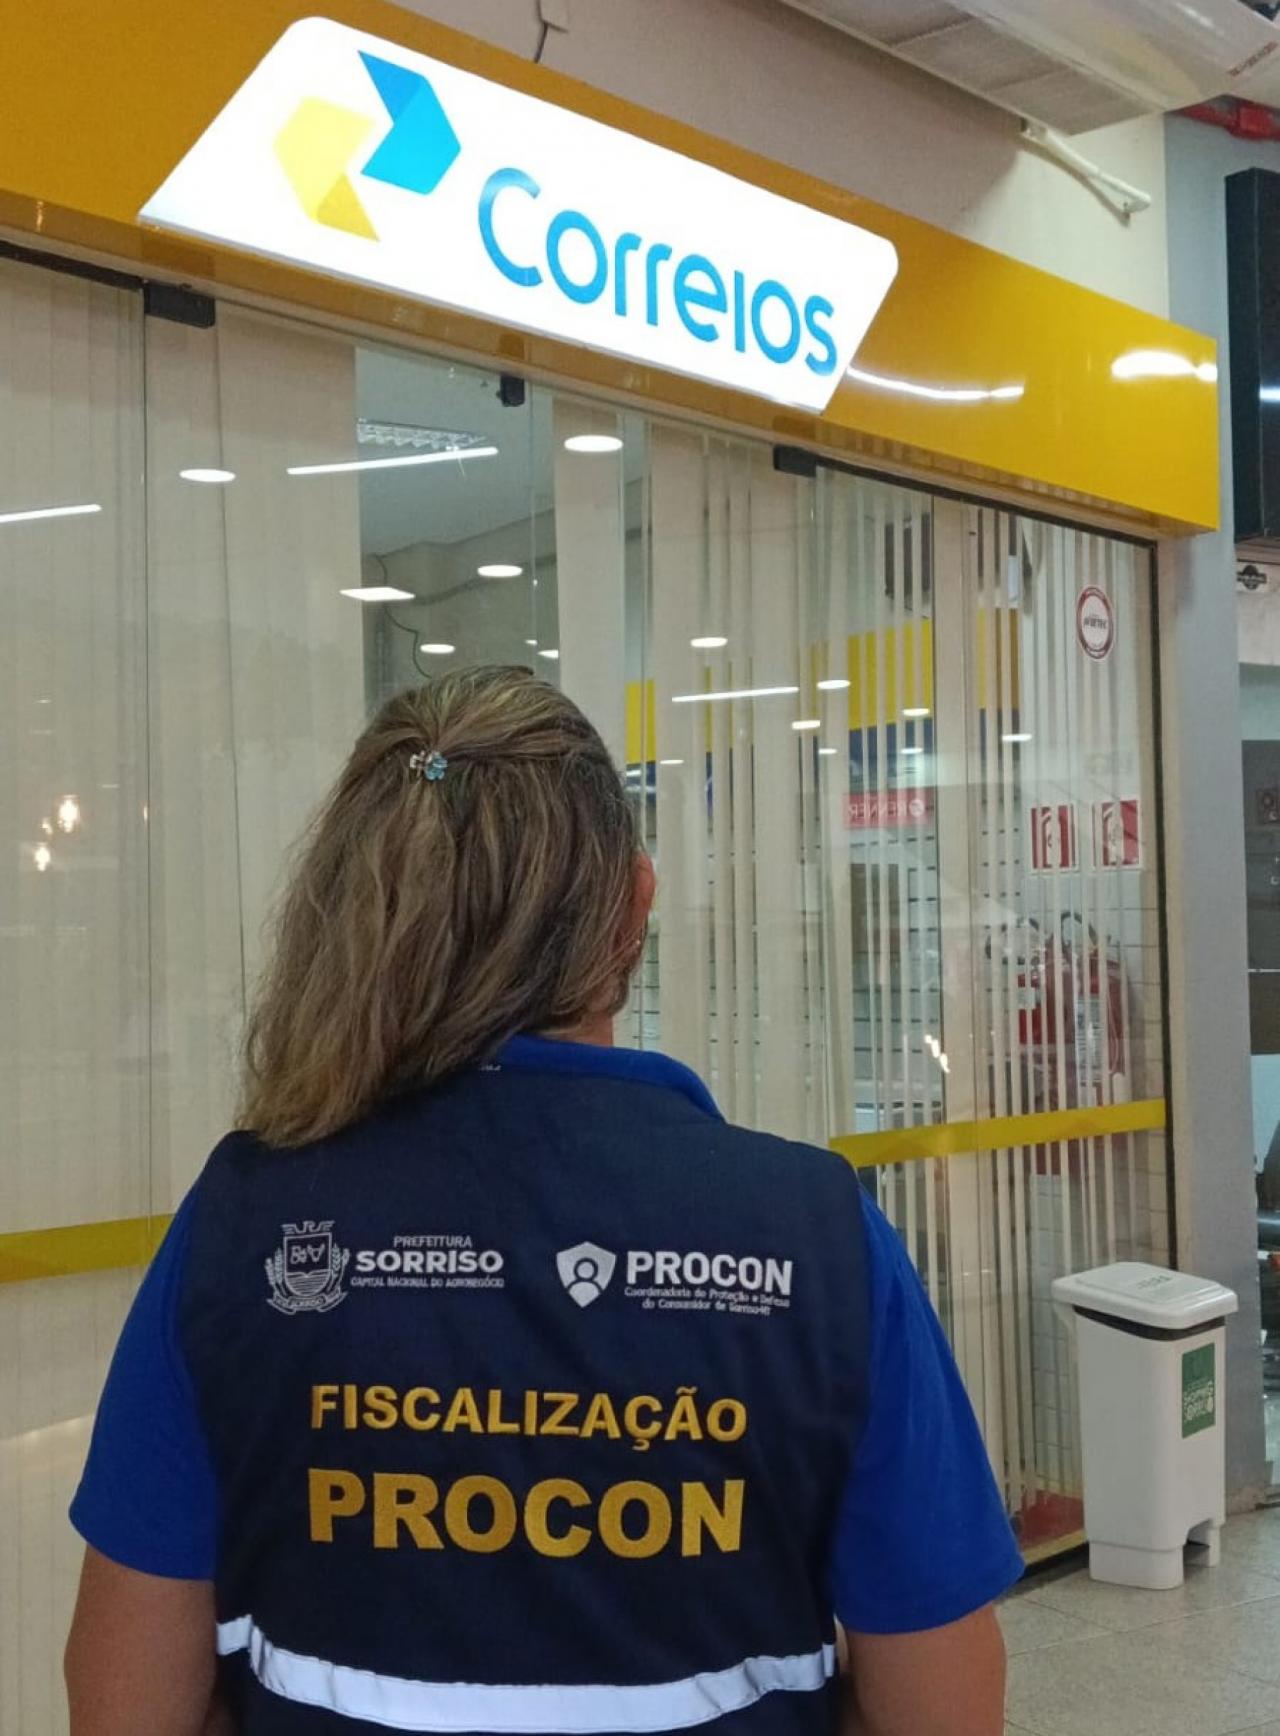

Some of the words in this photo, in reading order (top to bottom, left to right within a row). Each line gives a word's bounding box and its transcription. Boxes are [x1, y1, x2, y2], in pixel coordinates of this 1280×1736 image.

[478, 167, 837, 376] Correios
[355, 1250, 504, 1273] SORRISO
[393, 1235, 473, 1248] PREFEITURA
[350, 1276, 384, 1287] CAPITAL
[387, 1276, 428, 1287] NACIONAL
[431, 1277, 444, 1287] DO
[627, 1250, 793, 1296] PROCON
[310, 1384, 748, 1451] FISCALIZAÇÃO
[308, 1468, 745, 1558] PROCON
